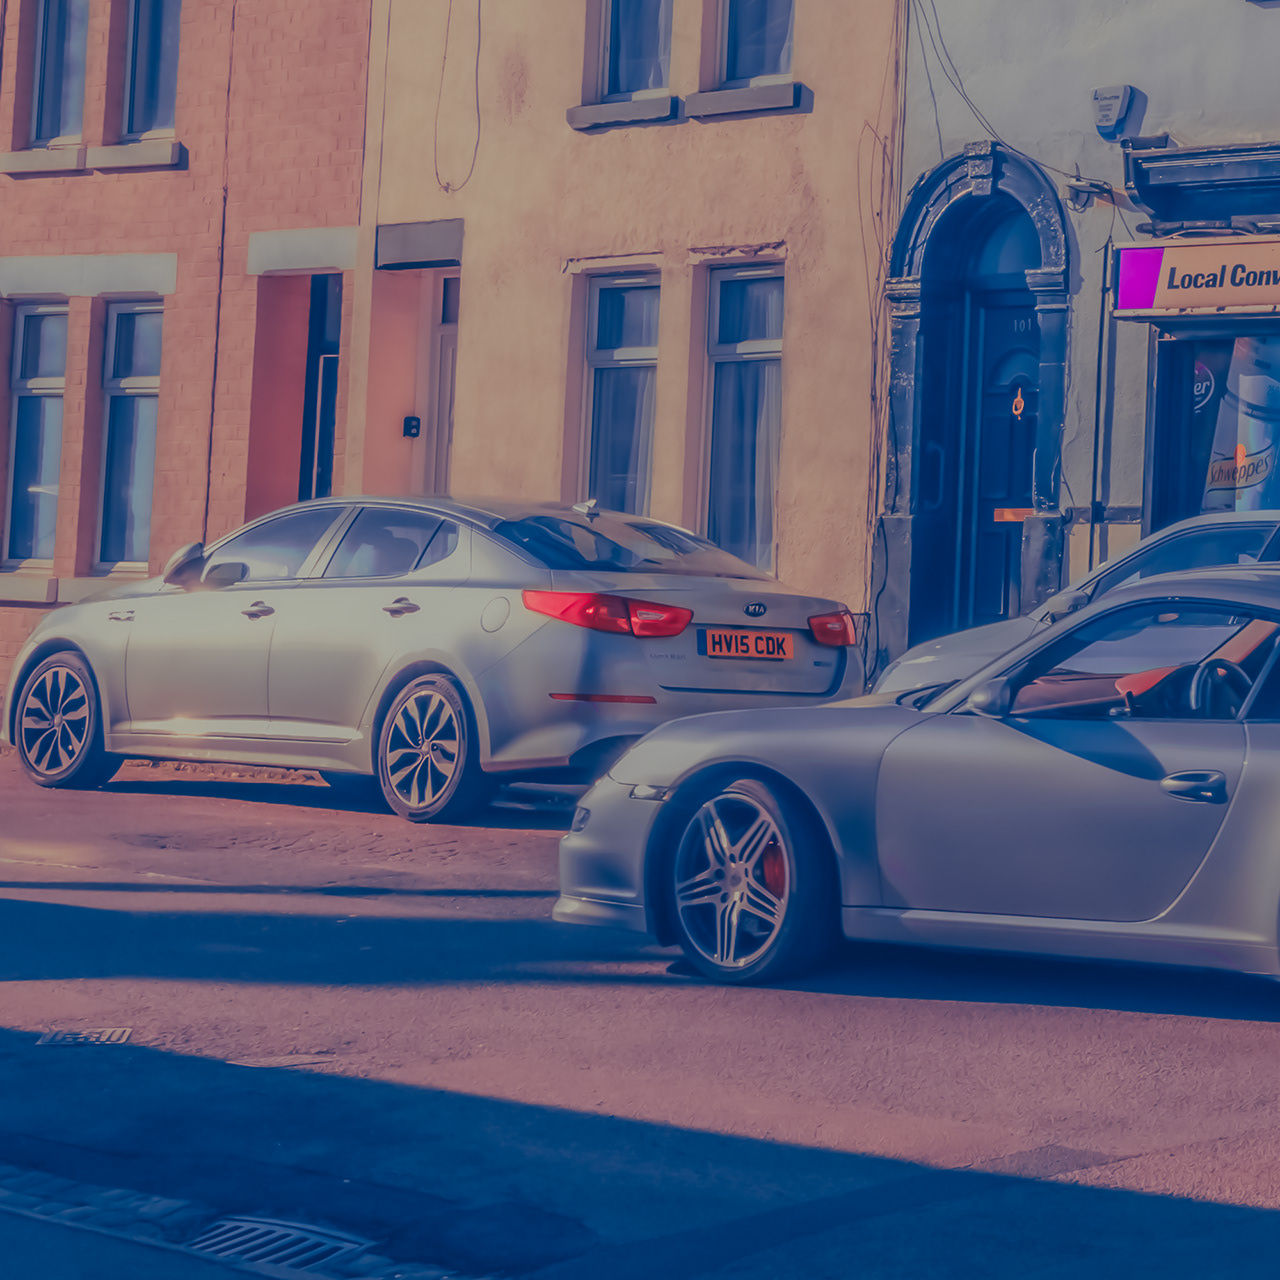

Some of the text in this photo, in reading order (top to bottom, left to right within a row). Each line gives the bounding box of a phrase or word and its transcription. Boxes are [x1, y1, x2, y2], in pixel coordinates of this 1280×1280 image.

[1167, 264, 1227, 290] Local
[1210, 454, 1270, 483] Schweppes
[748, 605, 765, 613] KIA
[711, 634, 786, 655] HV15 CDK
